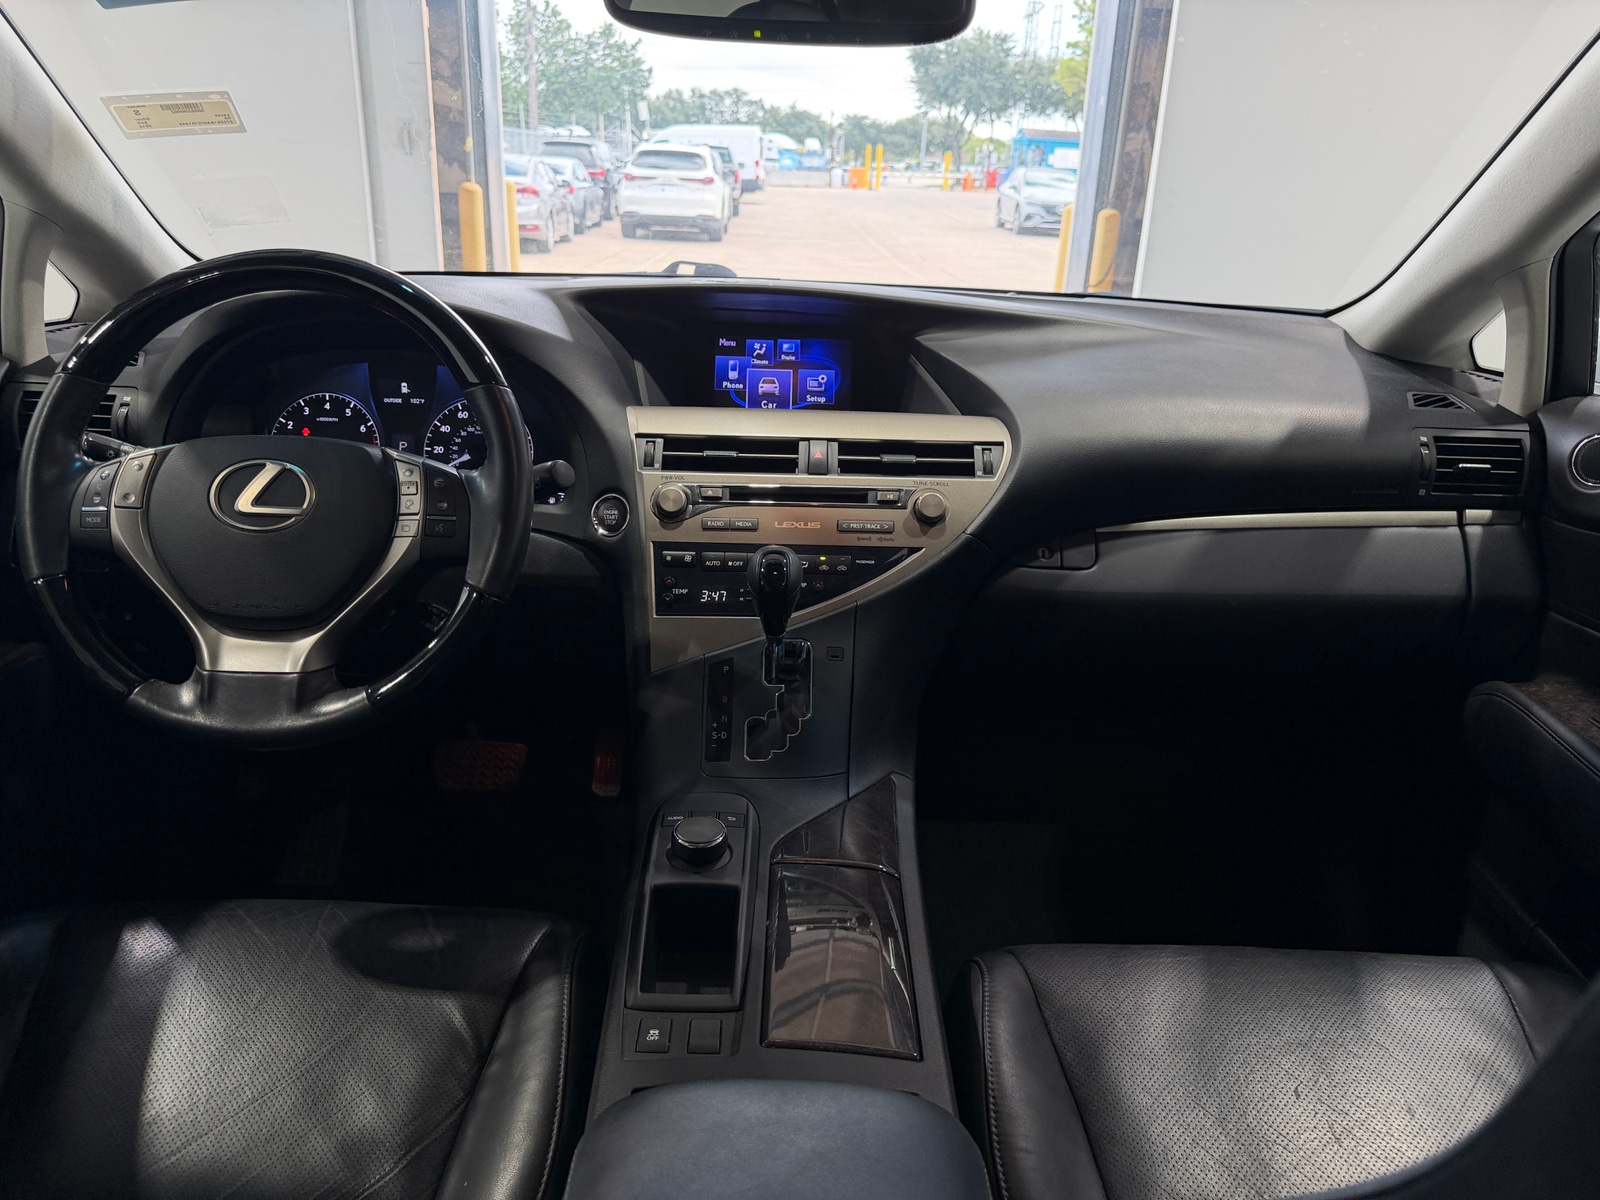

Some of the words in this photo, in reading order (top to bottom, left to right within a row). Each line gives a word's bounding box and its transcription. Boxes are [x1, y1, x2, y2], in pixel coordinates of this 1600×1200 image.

[719, 338, 736, 346] Menu
[806, 394, 826, 403] Setup
[324, 402, 330, 410] 4
[760, 400, 777, 409] Car
[303, 407, 310, 415] 3
[345, 408, 352, 416] 5
[287, 421, 294, 429] 2
[360, 425, 366, 433] 6
[399, 442, 408, 450] P
[700, 590, 727, 602] 3:47
